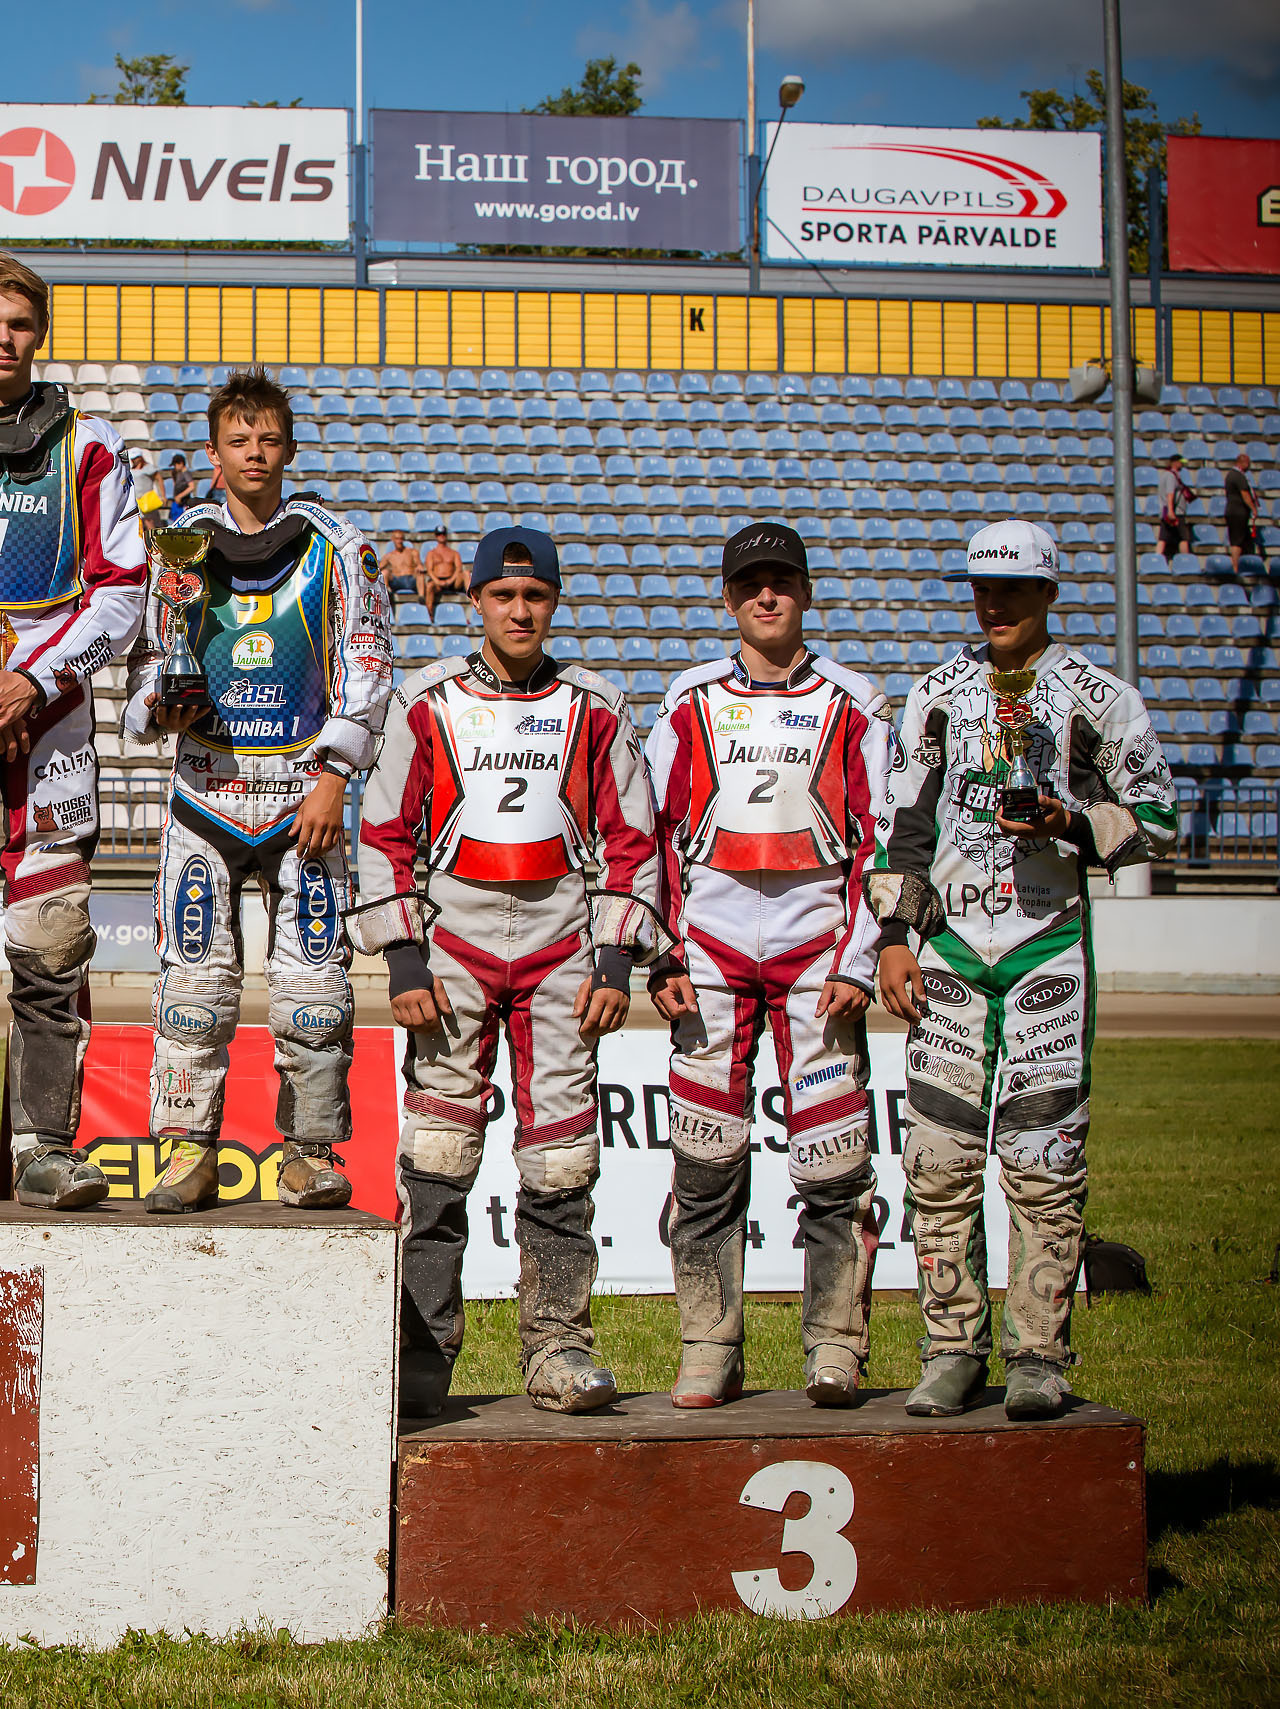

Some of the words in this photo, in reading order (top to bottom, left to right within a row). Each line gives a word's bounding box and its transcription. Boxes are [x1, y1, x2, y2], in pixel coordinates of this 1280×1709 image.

[91, 142, 336, 202] Nivels
[414, 143, 529, 183] Наш
[546, 155, 698, 195] город.
[803, 186, 1014, 209] DAUGAVPILS
[474, 202, 640, 222] www.gorod.lv
[800, 221, 907, 244] SPORTA
[918, 219, 1057, 249] PĀRVALDE
[689, 308, 705, 332] K
[207, 715, 284, 737] JAUNĪBA
[291, 716, 300, 737] 1
[464, 747, 559, 772] JAUNĪBA
[720, 740, 811, 766] JAUNĪBA
[209, 780, 244, 792] Auto
[497, 777, 528, 813] 2
[747, 770, 779, 804] 2
[53, 793, 92, 814] YOGGY
[61, 806, 91, 825] BEAR
[946, 882, 1013, 918] LPG
[1016, 885, 1051, 897] Latvijas
[1016, 897, 1051, 910] Propāna
[731, 1459, 857, 1621] 3
